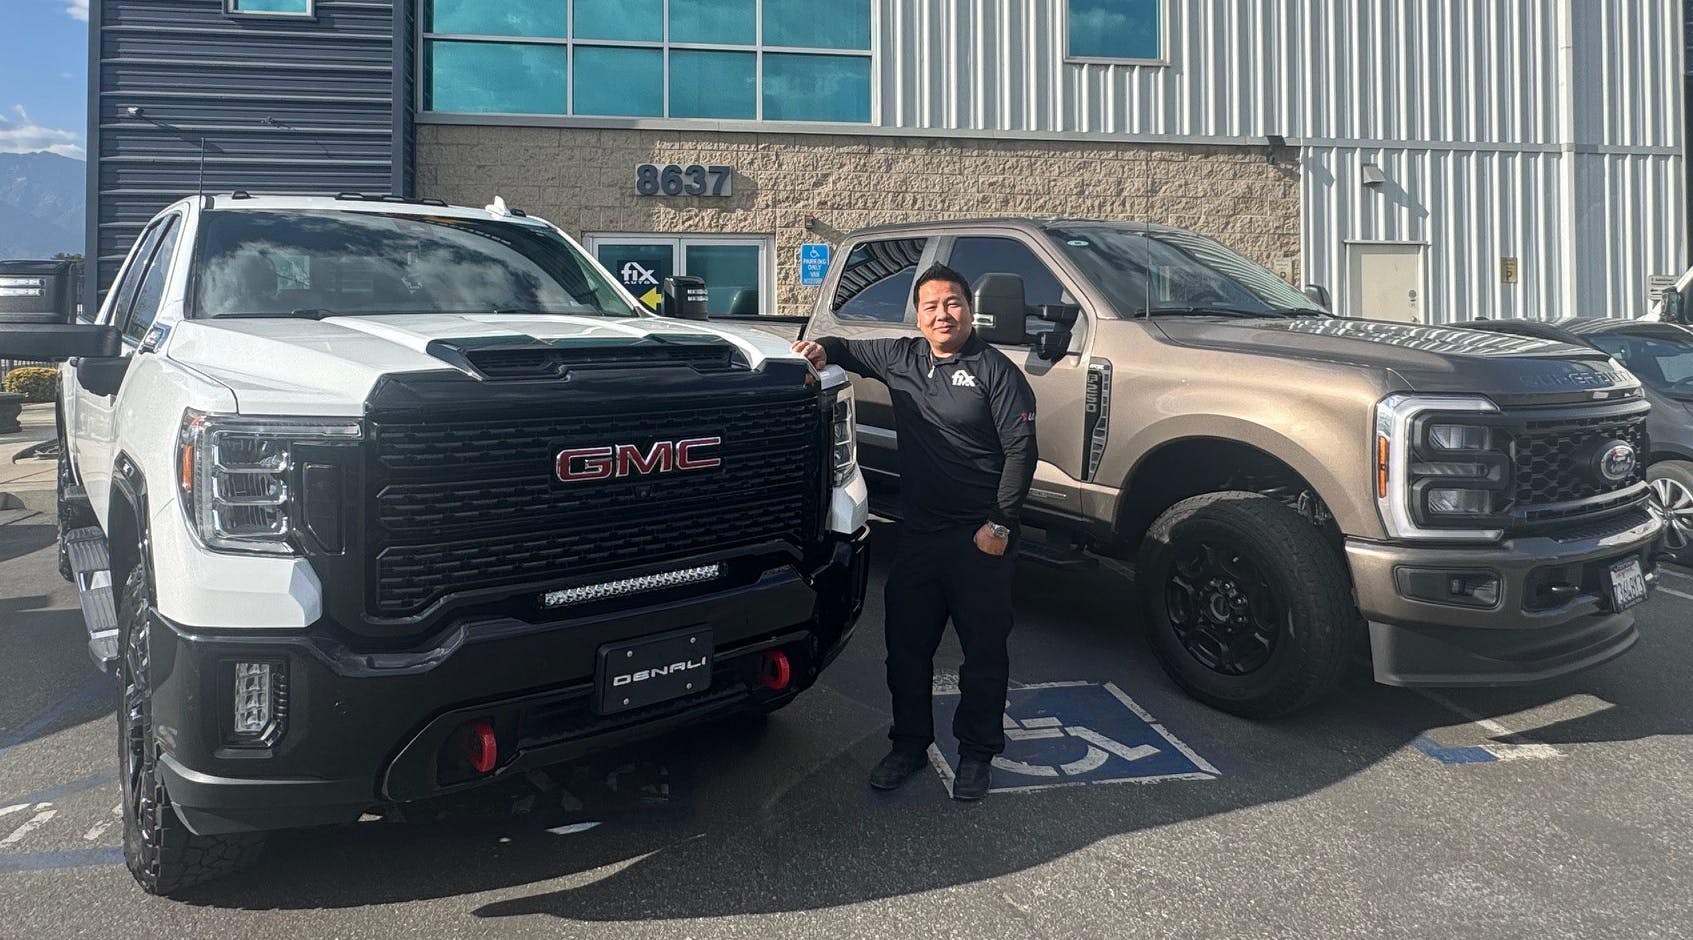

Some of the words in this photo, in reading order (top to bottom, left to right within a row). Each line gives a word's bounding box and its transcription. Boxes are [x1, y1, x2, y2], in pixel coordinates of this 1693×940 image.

[636, 164, 731, 196] 8637
[620, 261, 660, 285] fix
[951, 369, 977, 387] fix
[556, 436, 721, 482] GMC
[612, 656, 707, 687] DENALI
